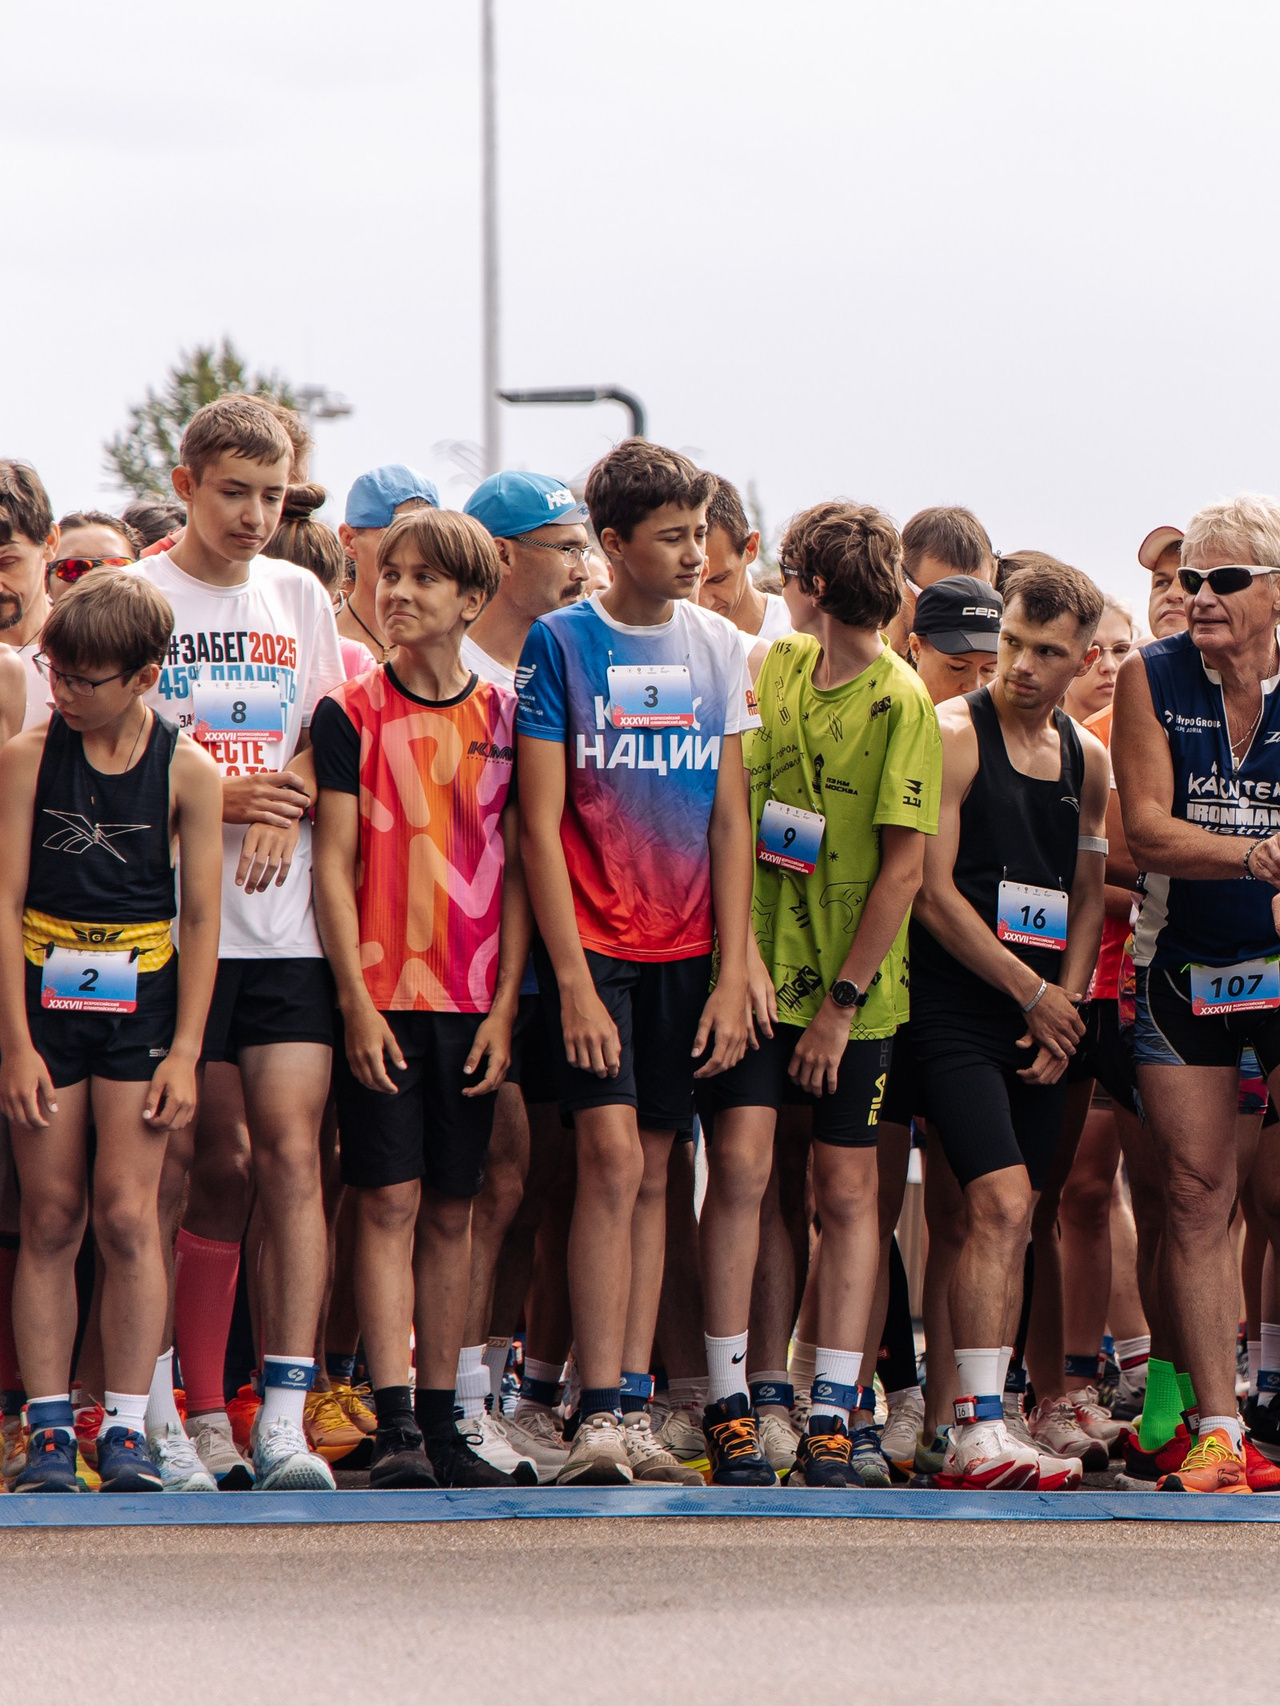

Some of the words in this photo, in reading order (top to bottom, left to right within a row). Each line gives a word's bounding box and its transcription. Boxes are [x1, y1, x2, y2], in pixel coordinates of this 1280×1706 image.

[962, 606, 999, 619] cep
[168, 631, 298, 670] #ЗАБЕГ2025
[643, 685, 659, 708] 3
[231, 700, 247, 723] 8
[620, 716, 650, 725] XXXVII
[204, 732, 236, 741] XXXVII
[576, 734, 721, 776] НАЦИИ
[825, 784, 859, 796] МОСКВА
[782, 827, 796, 849] 9
[759, 851, 782, 865] XXXVII
[1020, 905, 1046, 930] 16
[1003, 932, 1029, 944] XXXVII
[78, 968, 99, 992] 2
[1210, 974, 1263, 998] 107
[48, 1000, 83, 1010] XXXVII
[1199, 1005, 1232, 1015] XXXVII
[867, 1072, 887, 1126] FILA
